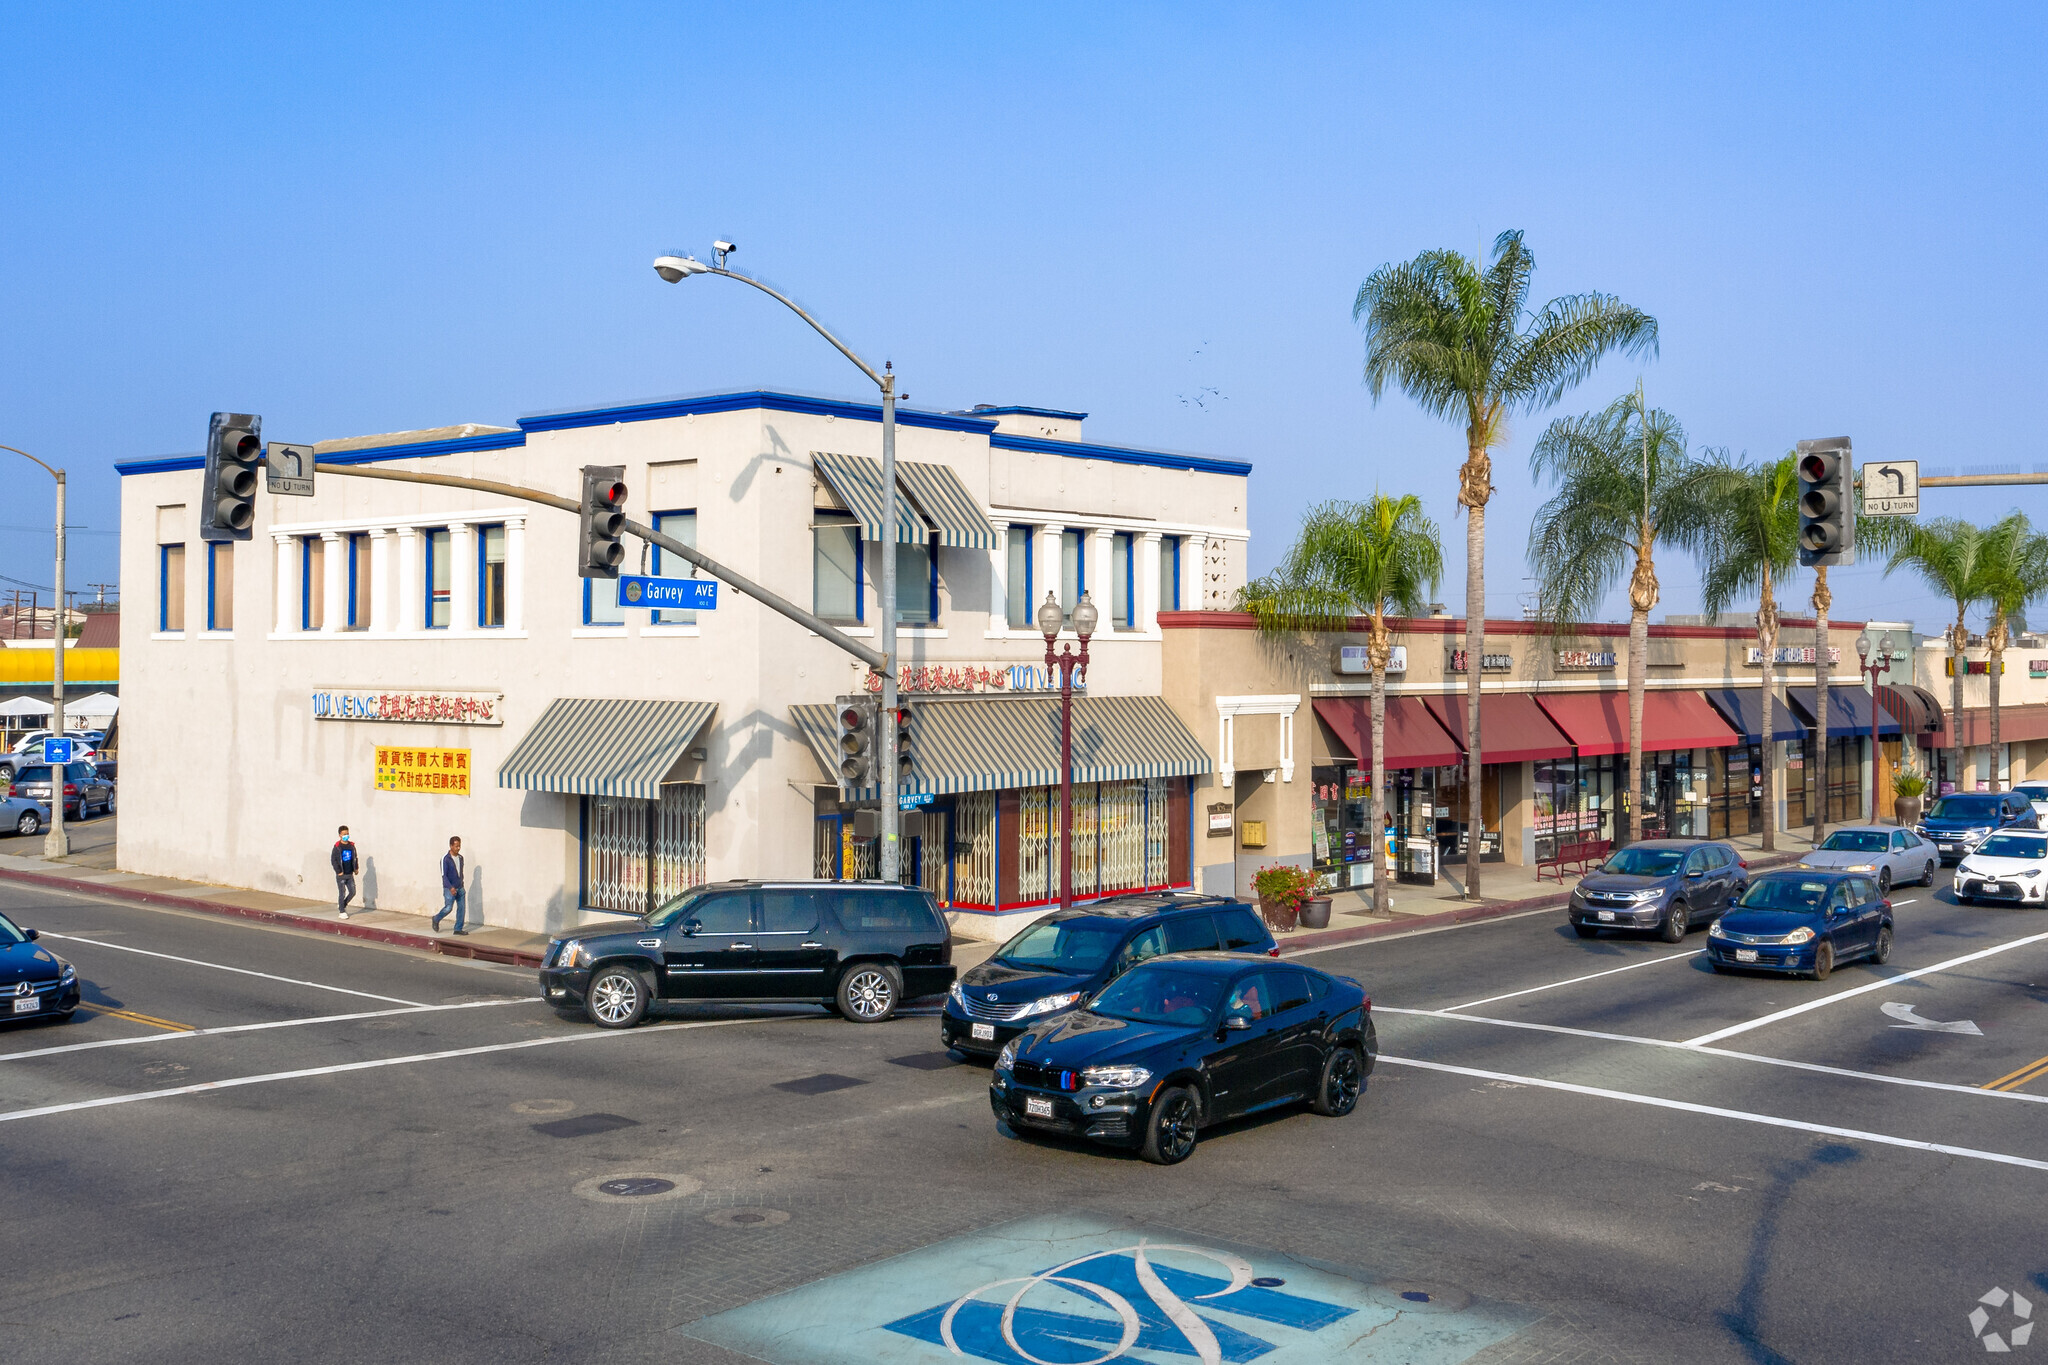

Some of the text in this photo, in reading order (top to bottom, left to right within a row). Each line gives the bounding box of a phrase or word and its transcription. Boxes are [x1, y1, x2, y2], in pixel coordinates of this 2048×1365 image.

[271, 481, 311, 491] NO U TURN
[1881, 501, 1890, 511] U
[1894, 501, 1914, 510] TURN
[647, 582, 714, 604] Garvey AVE
[1008, 665, 1033, 689] 101
[1059, 667, 1086, 688] IC.
[311, 693, 331, 716] 101
[335, 696, 349, 715] VE
[352, 696, 377, 718] INC.
[378, 750, 467, 769] 清貨特價大酬賓
[899, 795, 921, 804] GARVEY
